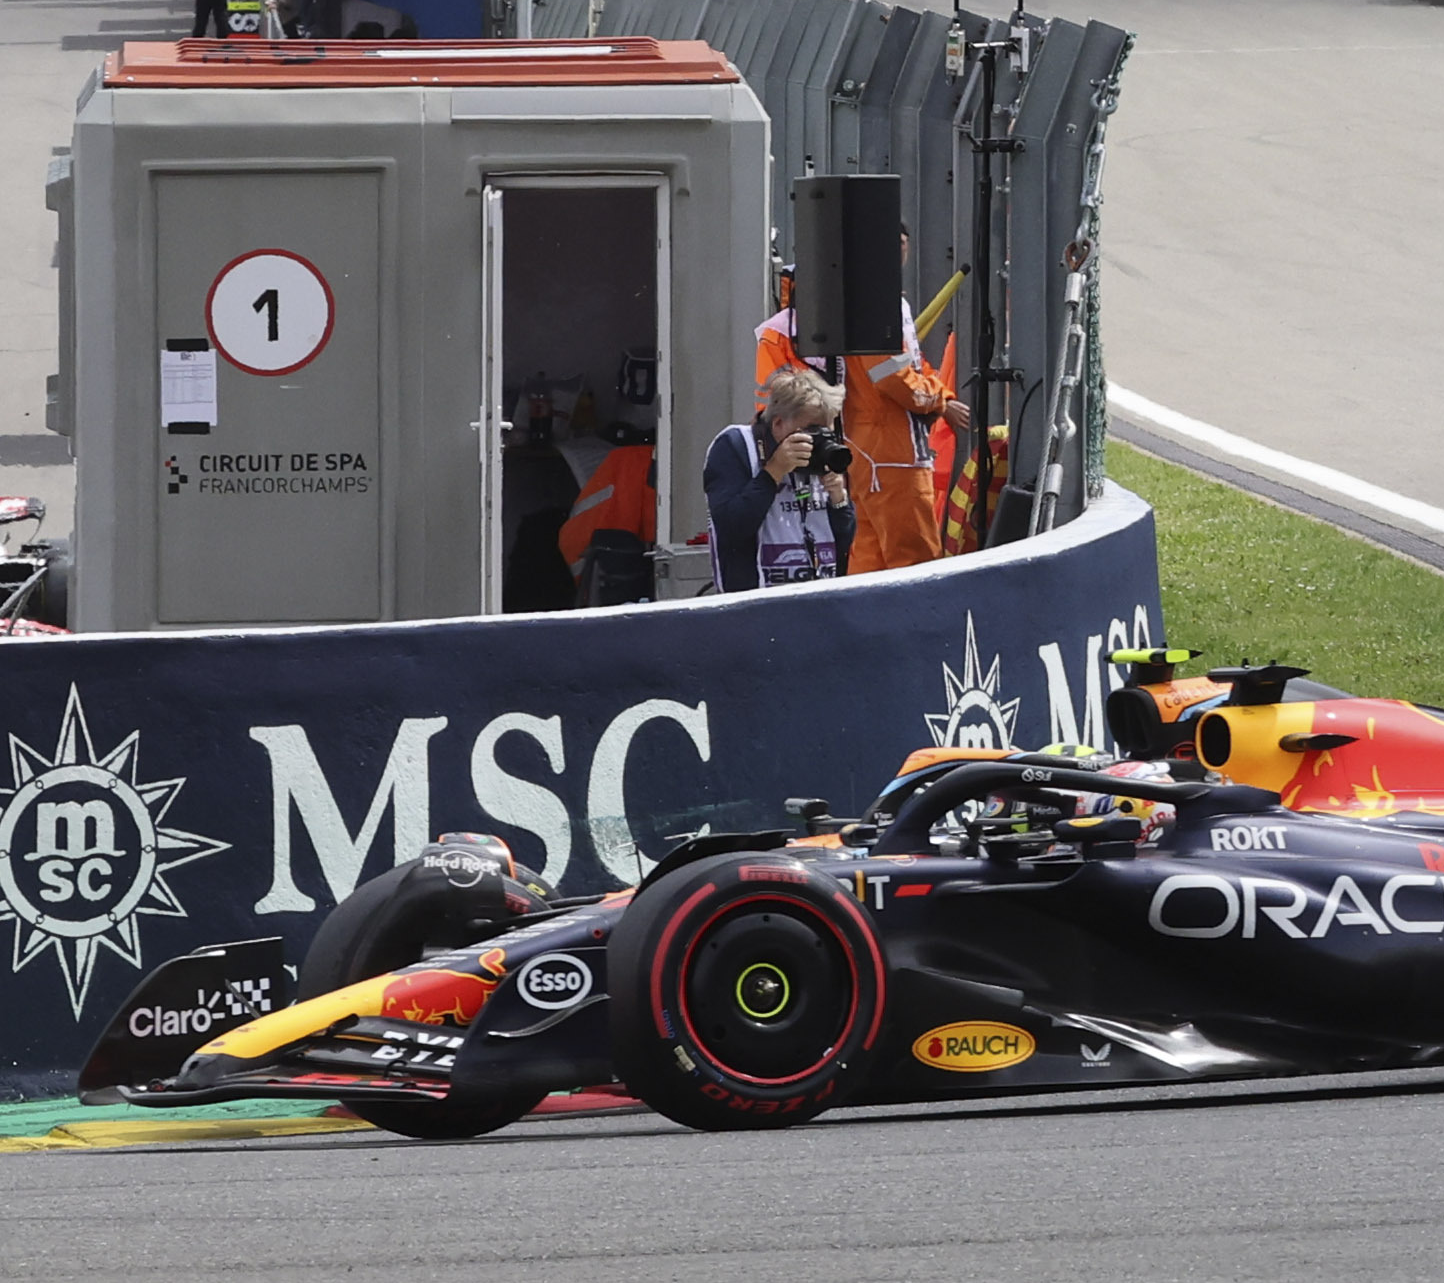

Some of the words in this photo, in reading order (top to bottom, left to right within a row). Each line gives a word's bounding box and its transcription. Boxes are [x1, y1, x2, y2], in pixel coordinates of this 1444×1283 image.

[253, 289, 278, 341] 1
[200, 455, 283, 472] CIRCUIT
[291, 454, 318, 471] DE
[326, 453, 368, 471] SPA
[200, 477, 368, 493] FRANCORCHAMPS
[780, 501, 800, 513] 139
[250, 699, 714, 913] MSC
[1210, 826, 1290, 852] ROKT
[424, 854, 461, 873] Hard
[461, 856, 500, 877] Rock
[529, 969, 582, 993] Esso
[129, 1001, 214, 1039] Claro
[946, 1035, 1020, 1059] RAUCH
[700, 1083, 806, 1114] ZERO
